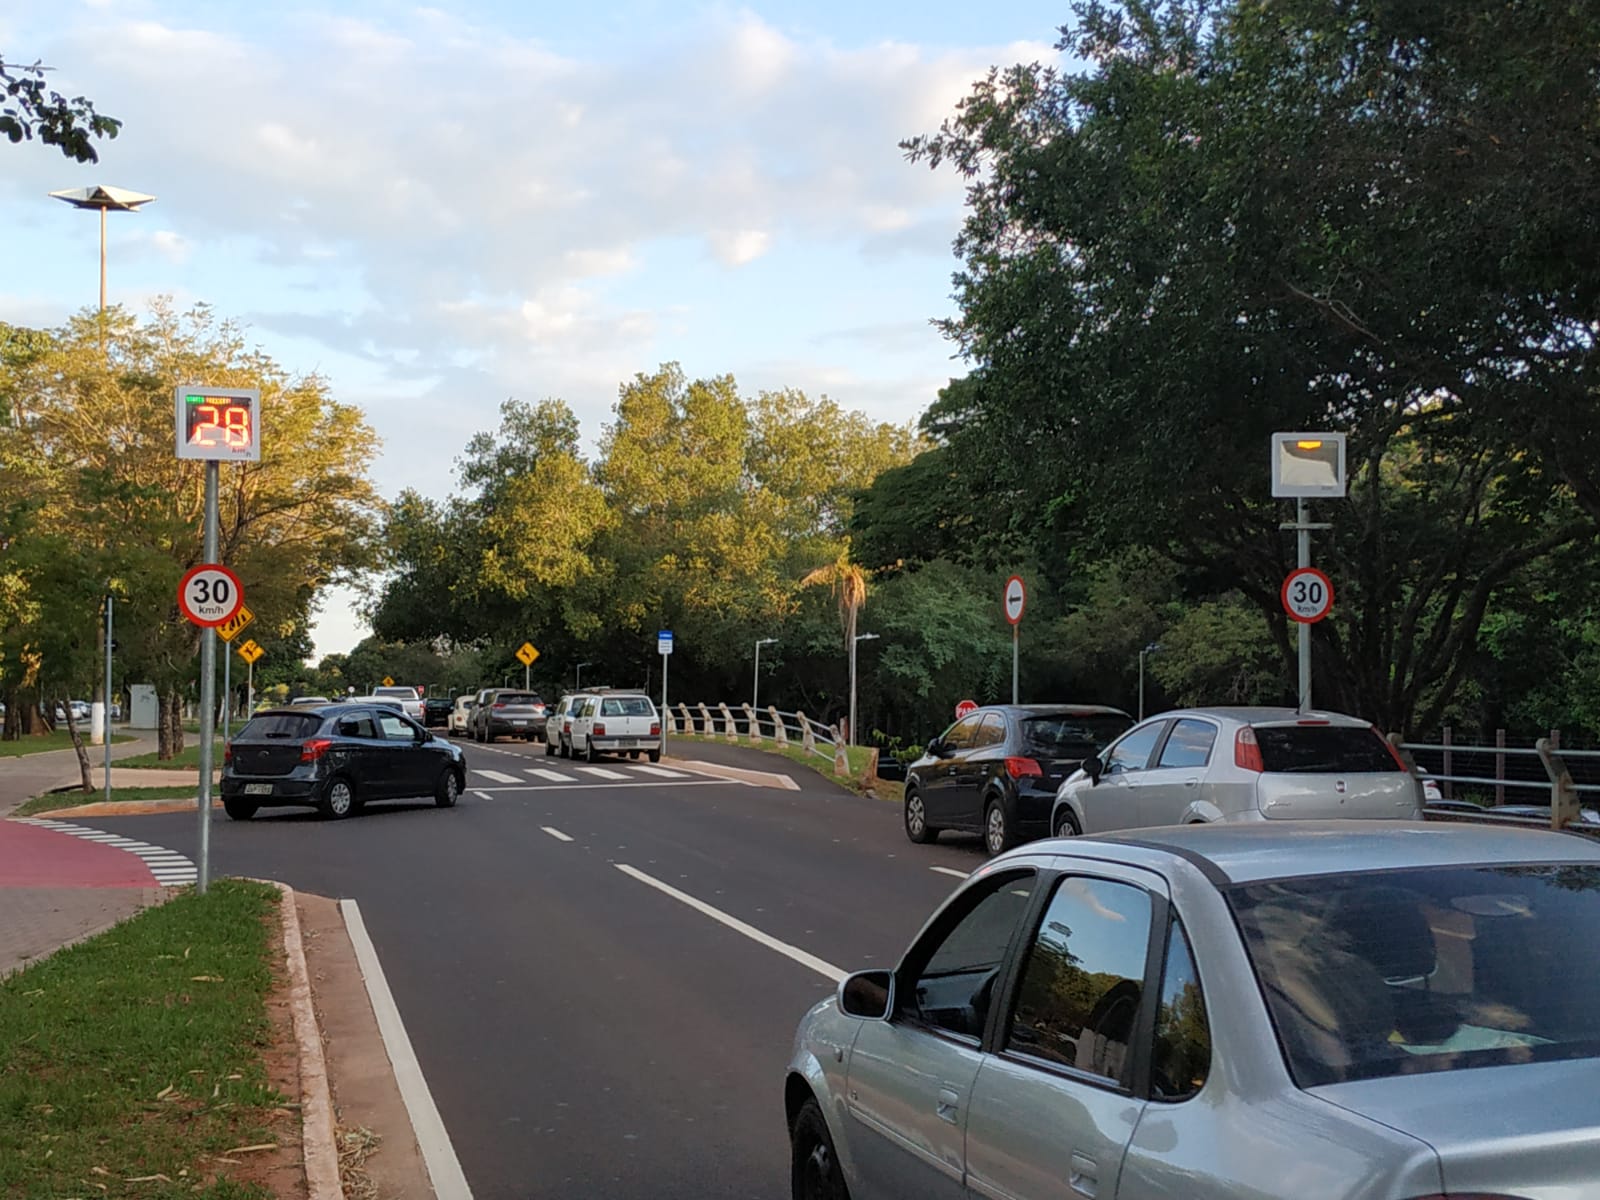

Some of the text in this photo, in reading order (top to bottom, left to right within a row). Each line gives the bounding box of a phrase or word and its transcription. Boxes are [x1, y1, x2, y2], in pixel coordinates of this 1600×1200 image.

[195, 406, 248, 446] 28
[193, 579, 229, 604] 30
[1293, 581, 1322, 604] 30
[199, 605, 224, 614] km/h
